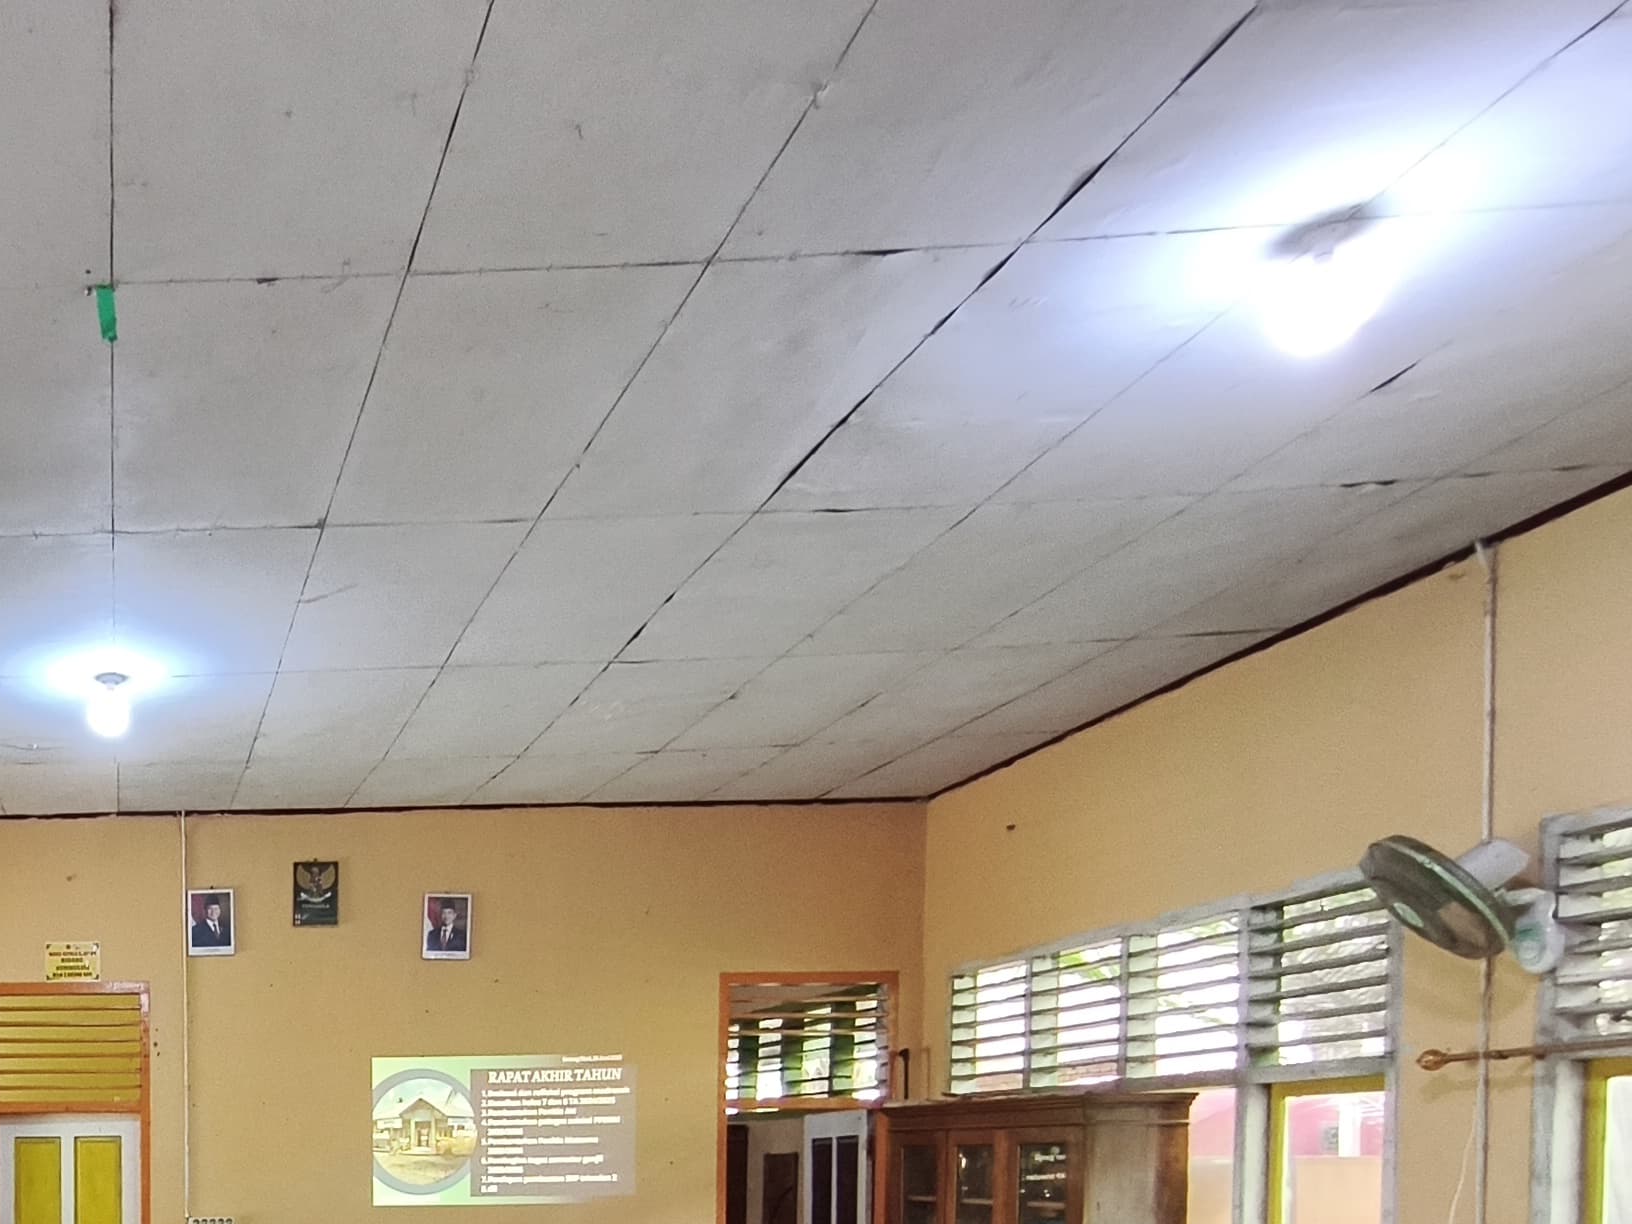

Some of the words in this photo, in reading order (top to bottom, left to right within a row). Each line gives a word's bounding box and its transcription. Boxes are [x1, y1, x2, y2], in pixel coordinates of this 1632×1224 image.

[488, 1071, 531, 1083] RAPAT
[531, 1070, 572, 1082] AKHIR
[574, 1068, 623, 1081] TAHUN
